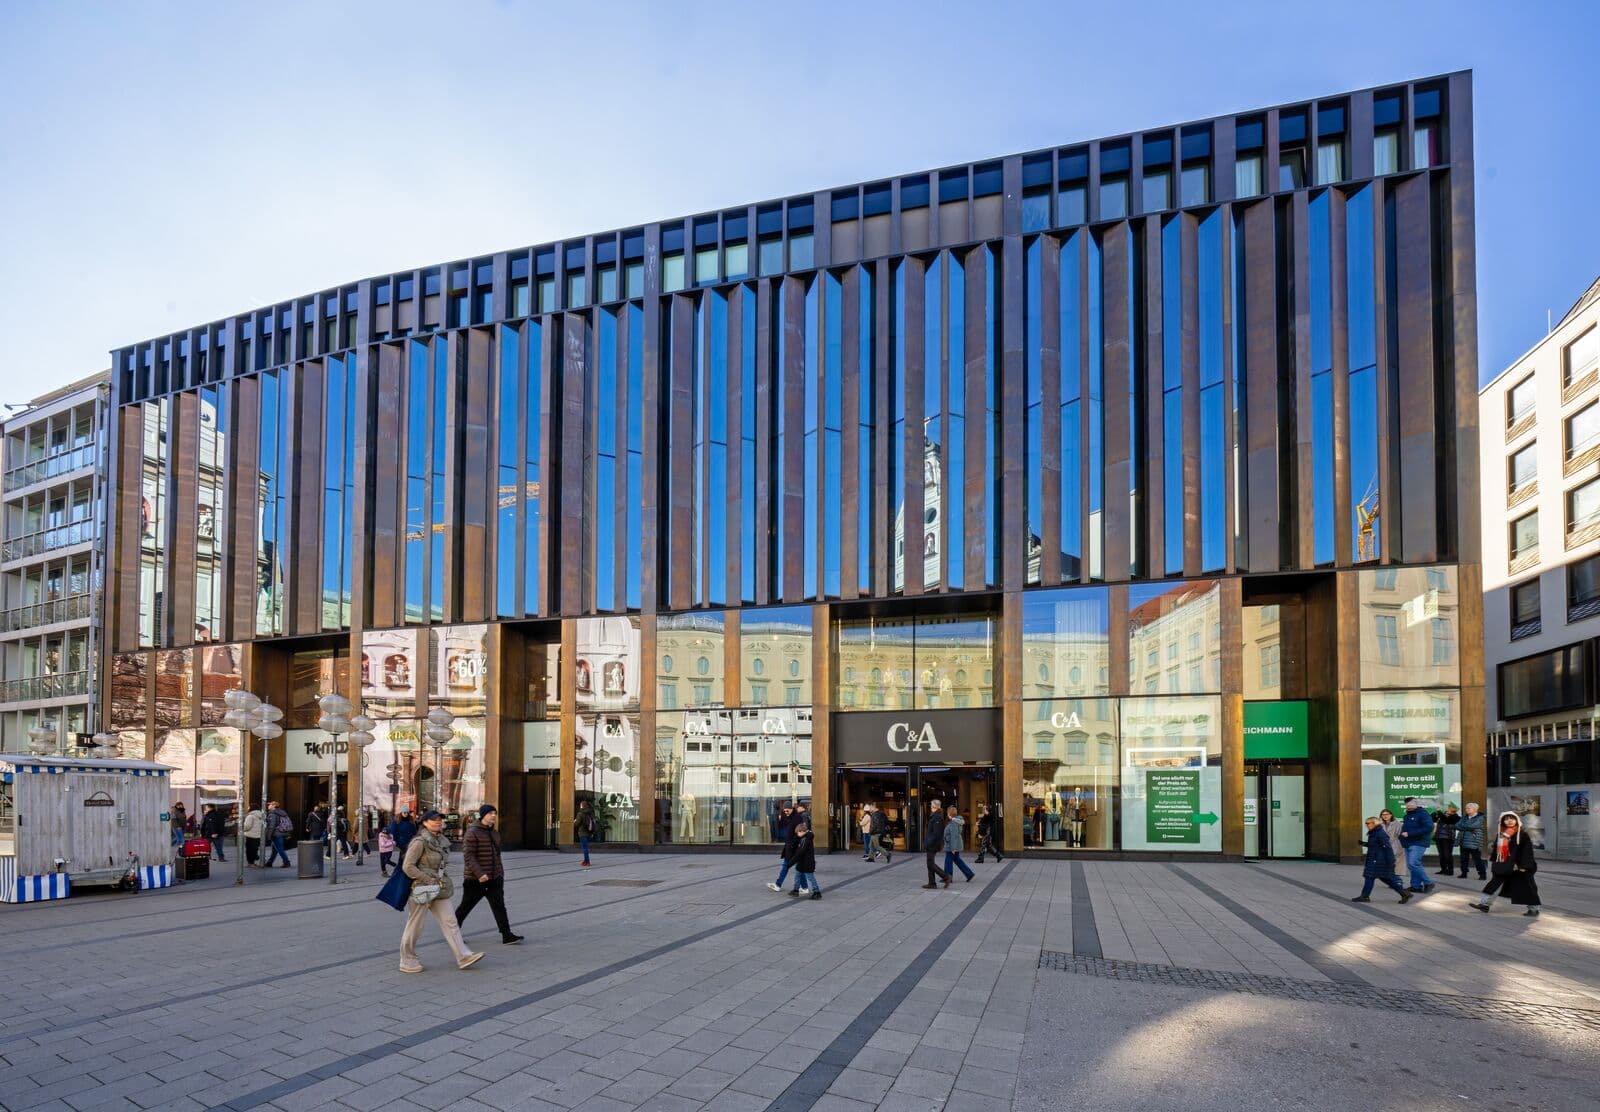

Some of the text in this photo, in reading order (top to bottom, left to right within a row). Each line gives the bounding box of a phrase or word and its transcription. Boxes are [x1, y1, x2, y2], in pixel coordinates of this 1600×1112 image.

[458, 659, 487, 678] 60%
[1051, 711, 1082, 728] C&A
[602, 723, 625, 738] C&A
[887, 722, 942, 752] C&A
[1242, 726, 1293, 734] EICHMANN
[606, 791, 634, 808] C&A
